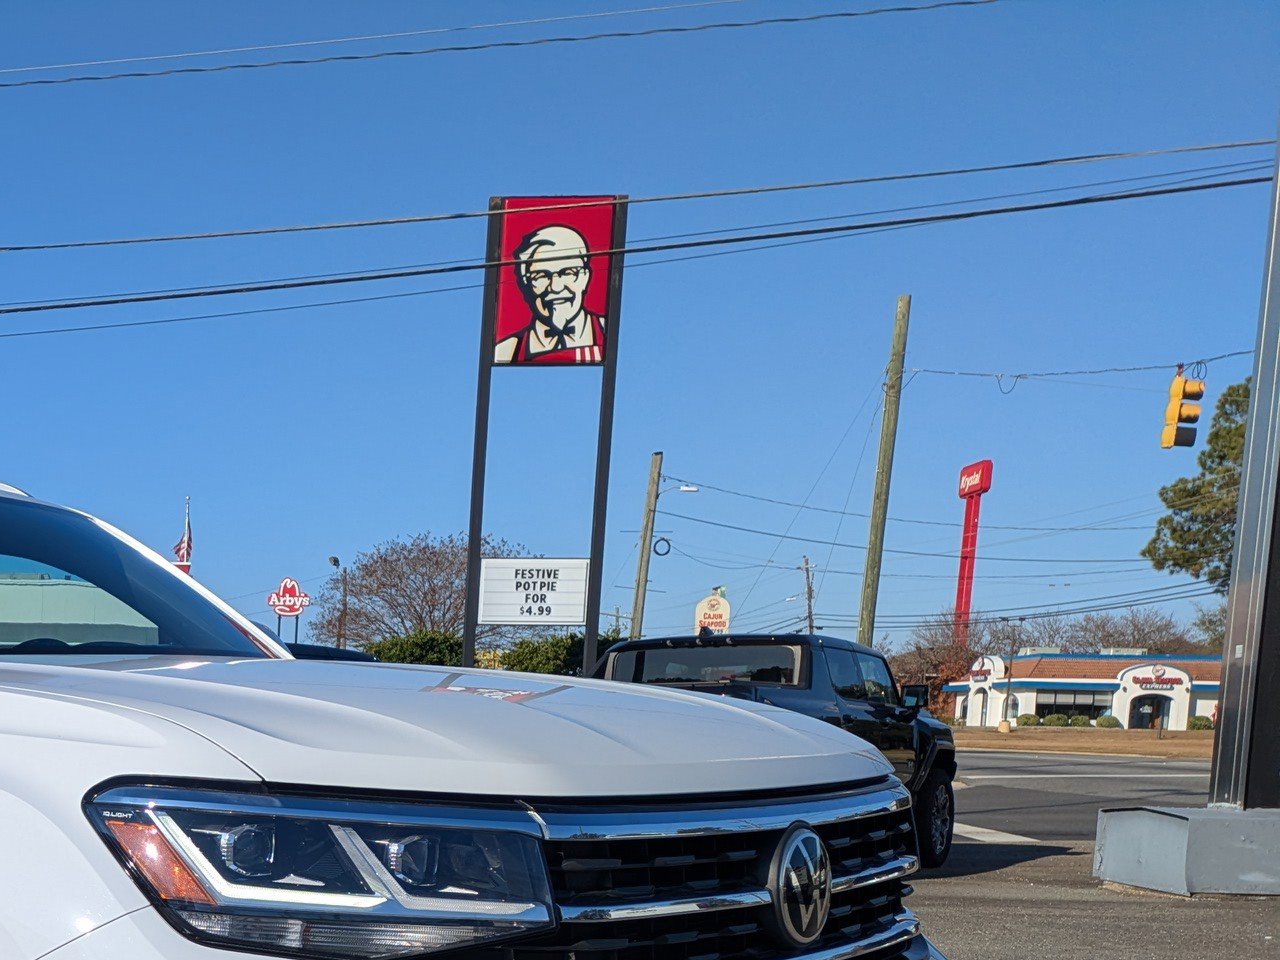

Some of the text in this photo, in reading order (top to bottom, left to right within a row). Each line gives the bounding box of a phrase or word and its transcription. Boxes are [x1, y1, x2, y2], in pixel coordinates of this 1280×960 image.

[960, 469, 981, 492] Krystal
[515, 569, 559, 579] FESTIVE
[269, 593, 310, 609] Arby's
[525, 593, 547, 603] FOR
[519, 605, 551, 616] $4.99
[703, 612, 723, 620] CAJUN
